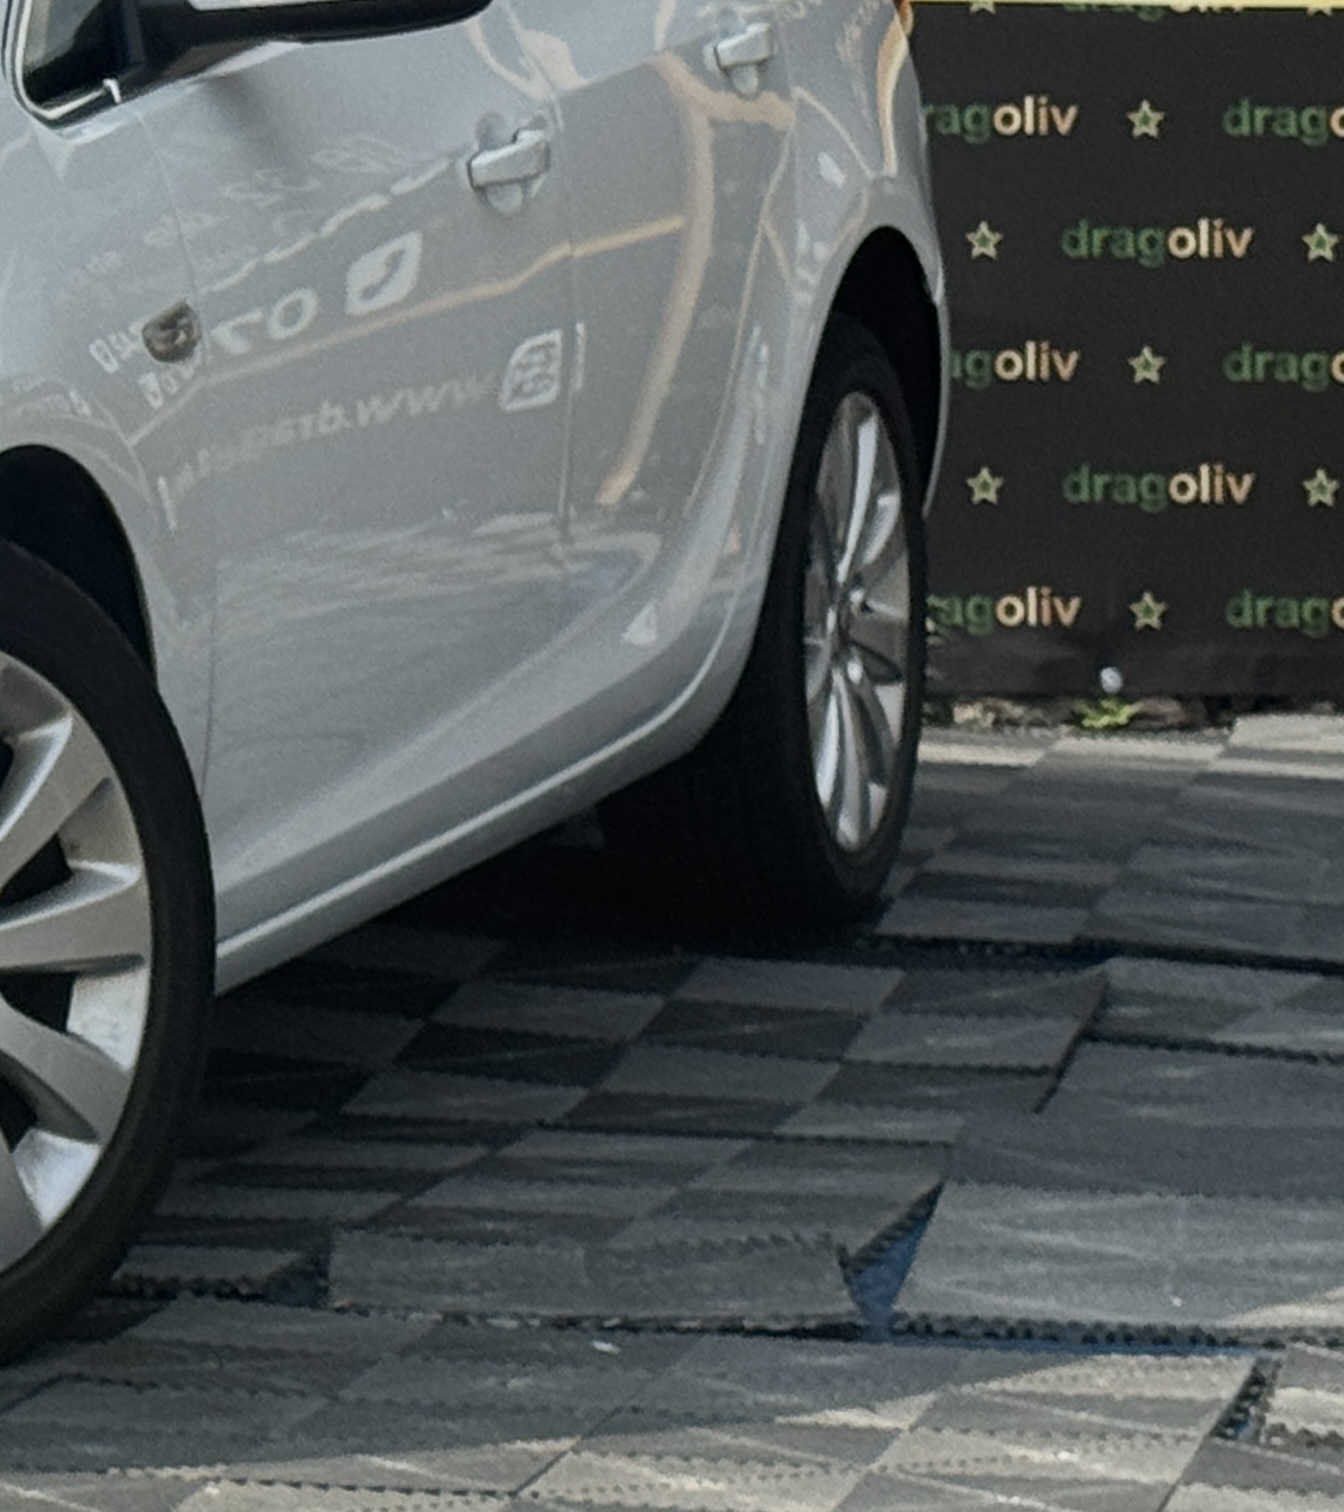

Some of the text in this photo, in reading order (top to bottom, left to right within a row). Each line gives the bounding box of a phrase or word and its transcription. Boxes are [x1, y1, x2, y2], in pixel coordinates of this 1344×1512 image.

[923, 94, 1079, 144] agoliv
[1060, 217, 1254, 267] dragoliv
[1062, 462, 1257, 513] dragoliv
